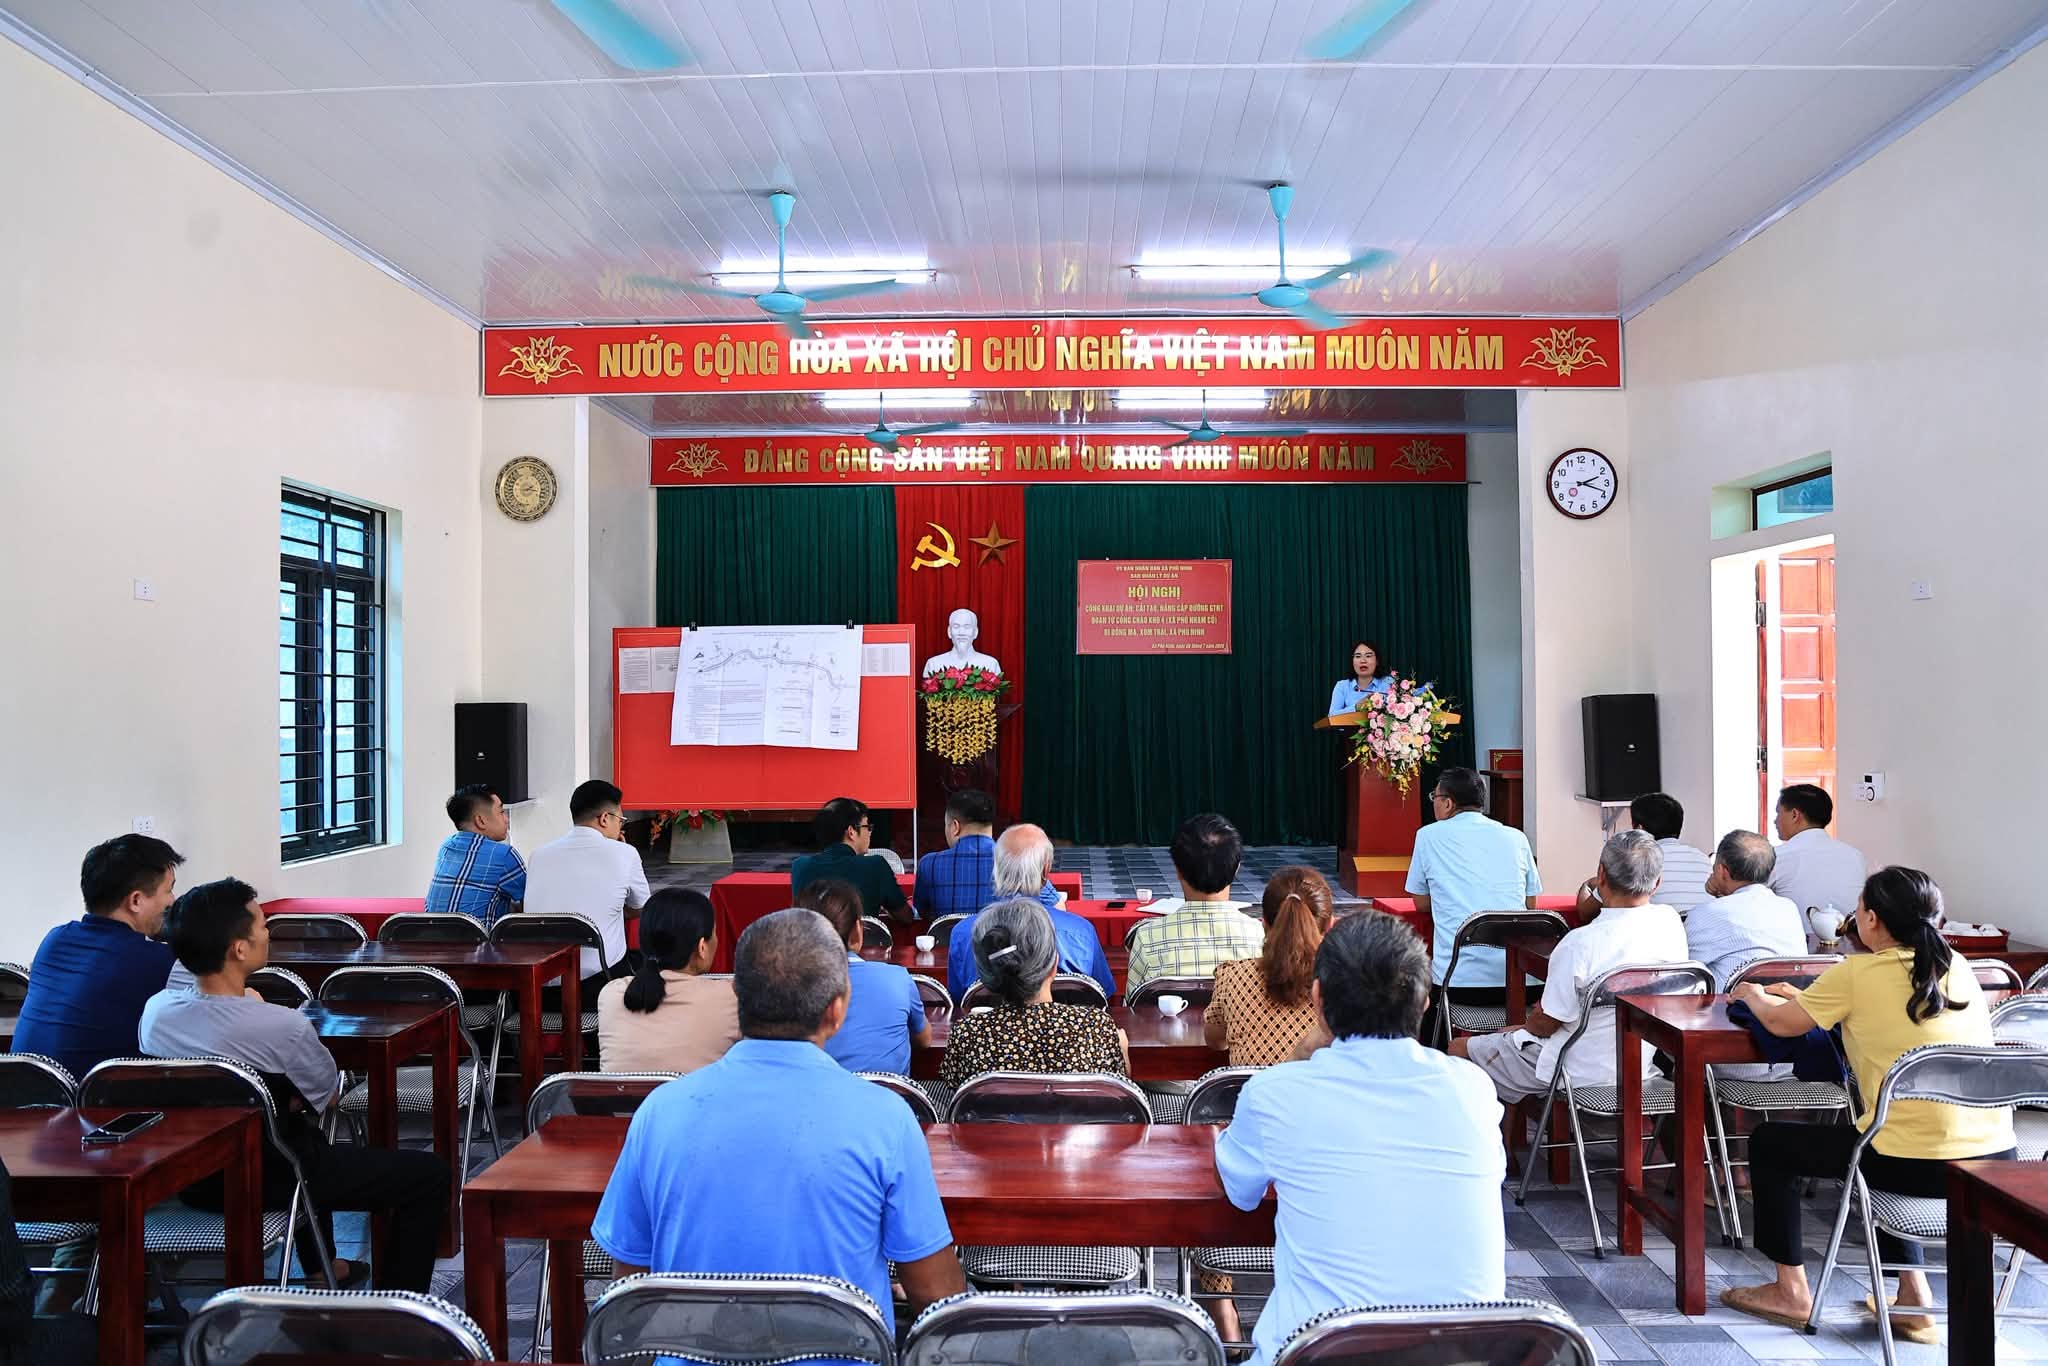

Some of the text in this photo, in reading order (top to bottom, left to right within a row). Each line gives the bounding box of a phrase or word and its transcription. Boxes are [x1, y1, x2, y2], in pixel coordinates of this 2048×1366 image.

[599, 324, 1503, 383] NƯỚC CỘNG HÒA XÃ HỘI CHỦ NGHĨA VIỆT NAM MUÔN NĂM
[744, 438, 1375, 478] ĐẢNG CỘNG SẢN VIỆT NAM QUANG VINH MUÔN NĂM
[1576, 455, 1586, 464] 12
[1592, 458, 1596, 467] 1
[1566, 459, 1574, 468] 11
[1557, 468, 1567, 477] 10
[1599, 466, 1606, 475] 2
[1554, 480, 1560, 489] 9
[1604, 478, 1610, 487] 3
[1558, 492, 1565, 501] 8
[1568, 500, 1574, 509] 7
[1580, 504, 1586, 512] 6
[1592, 500, 1598, 509] 5
[1128, 584, 1181, 601] HỘI NGHỊ
